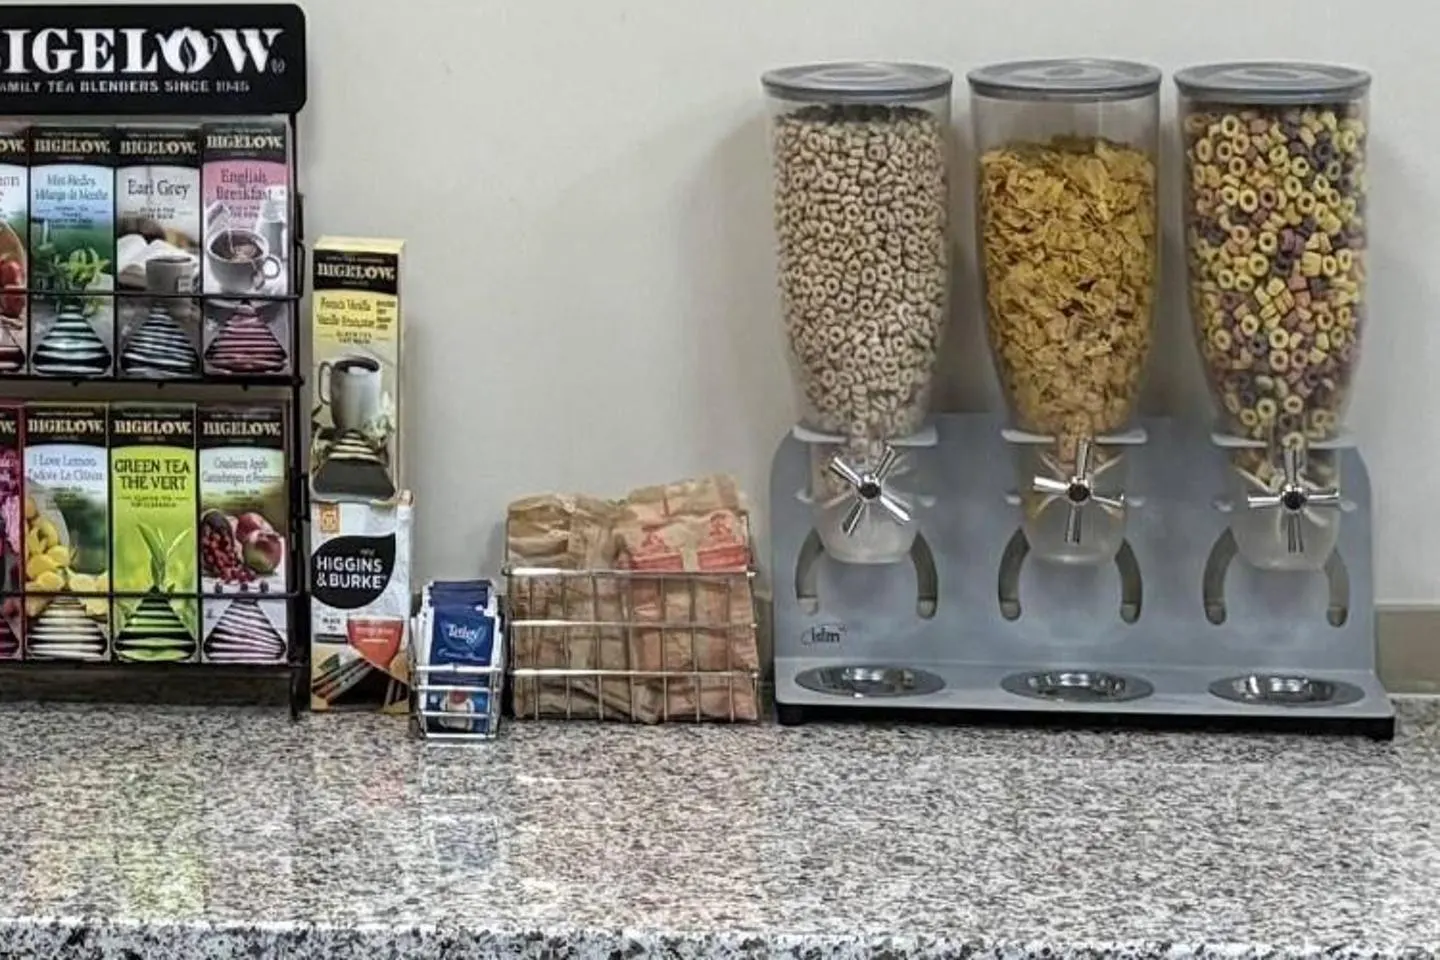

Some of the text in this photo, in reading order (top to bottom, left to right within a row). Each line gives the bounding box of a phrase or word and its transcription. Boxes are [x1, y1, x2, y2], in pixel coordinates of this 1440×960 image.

[47, 80, 75, 93] TEA
[80, 80, 159, 93] BLENDERS
[164, 80, 210, 93] SINCE
[34, 139, 111, 153] BIGELOW
[119, 140, 197, 154] BIGELOW
[206, 135, 284, 149] BIGELOW
[220, 167, 268, 187] English
[127, 178, 191, 200] Earl Grey
[216, 185, 272, 201] Breakfast
[317, 262, 395, 280] BIGELOW
[27, 419, 105, 433] BIGELOW
[113, 420, 192, 434] BIGELOW
[202, 421, 282, 436] BIGELOW
[114, 458, 191, 474] GREEN TEA
[149, 475, 188, 491] VERT
[316, 556, 384, 573] HIGGINS
[329, 573, 383, 589] BURKE
